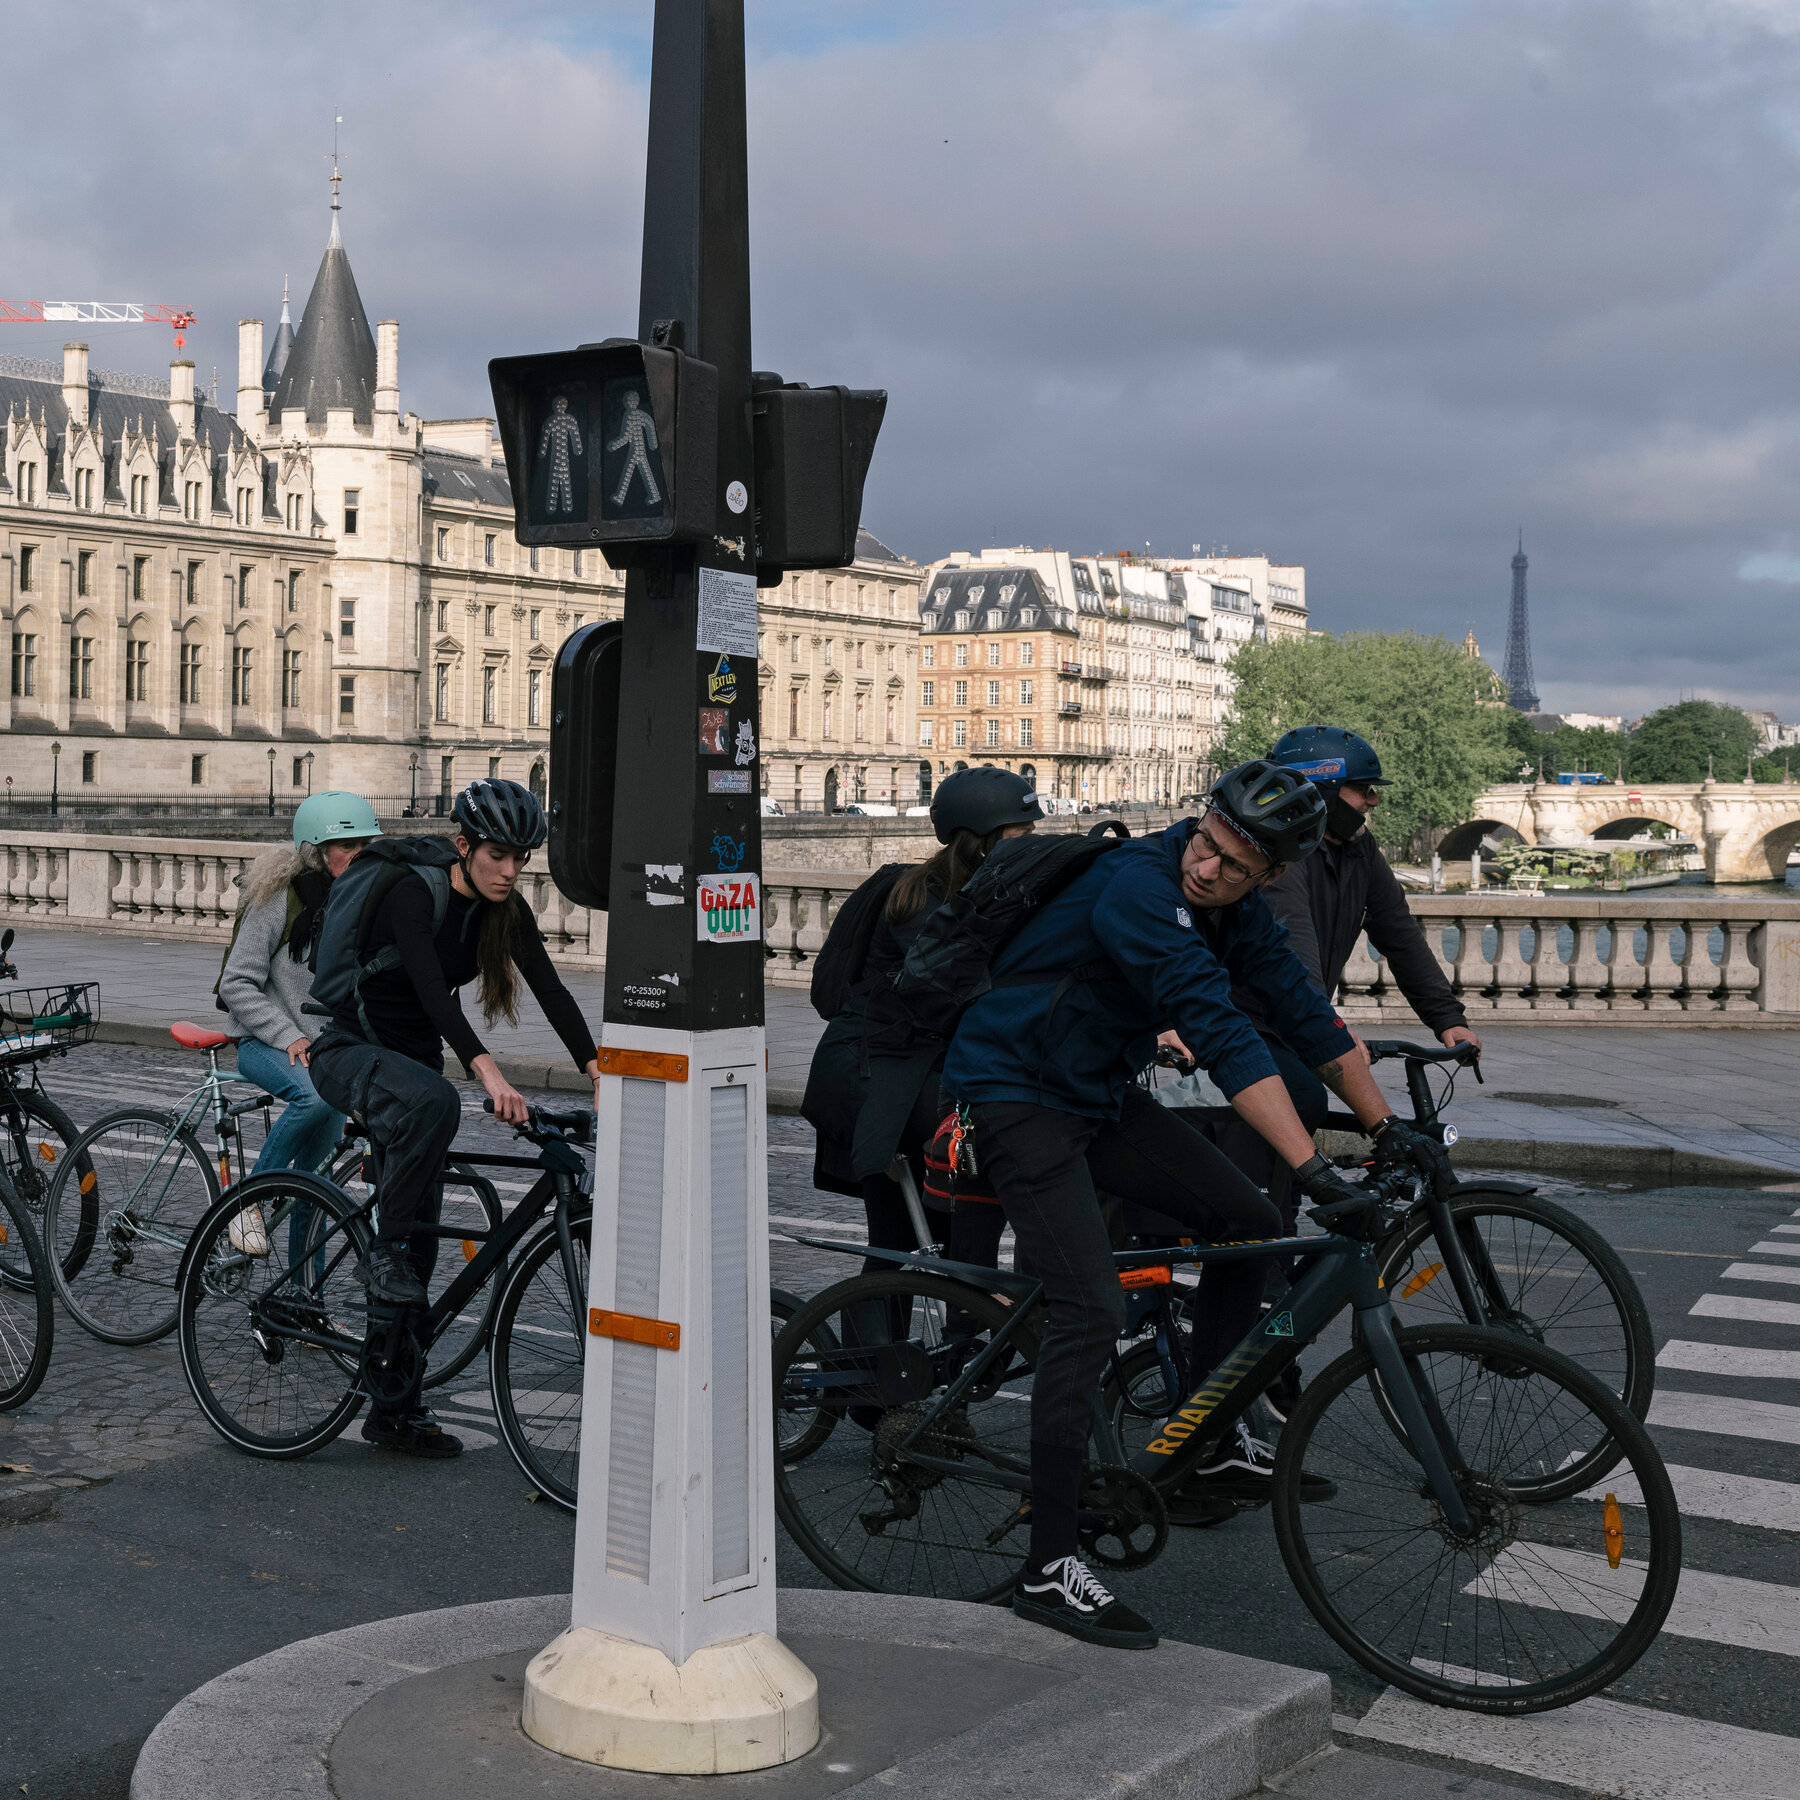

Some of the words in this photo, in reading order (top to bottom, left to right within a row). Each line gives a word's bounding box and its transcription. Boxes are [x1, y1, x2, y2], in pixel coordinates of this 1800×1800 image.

[712, 675, 726, 692] NEXT
[701, 883, 756, 912] GAZA
[707, 905, 750, 934] OUI!
[626, 985, 662, 996] PC-25300
[628, 998, 660, 1009] S-60465
[1145, 1340, 1270, 1456] ROADLITE
